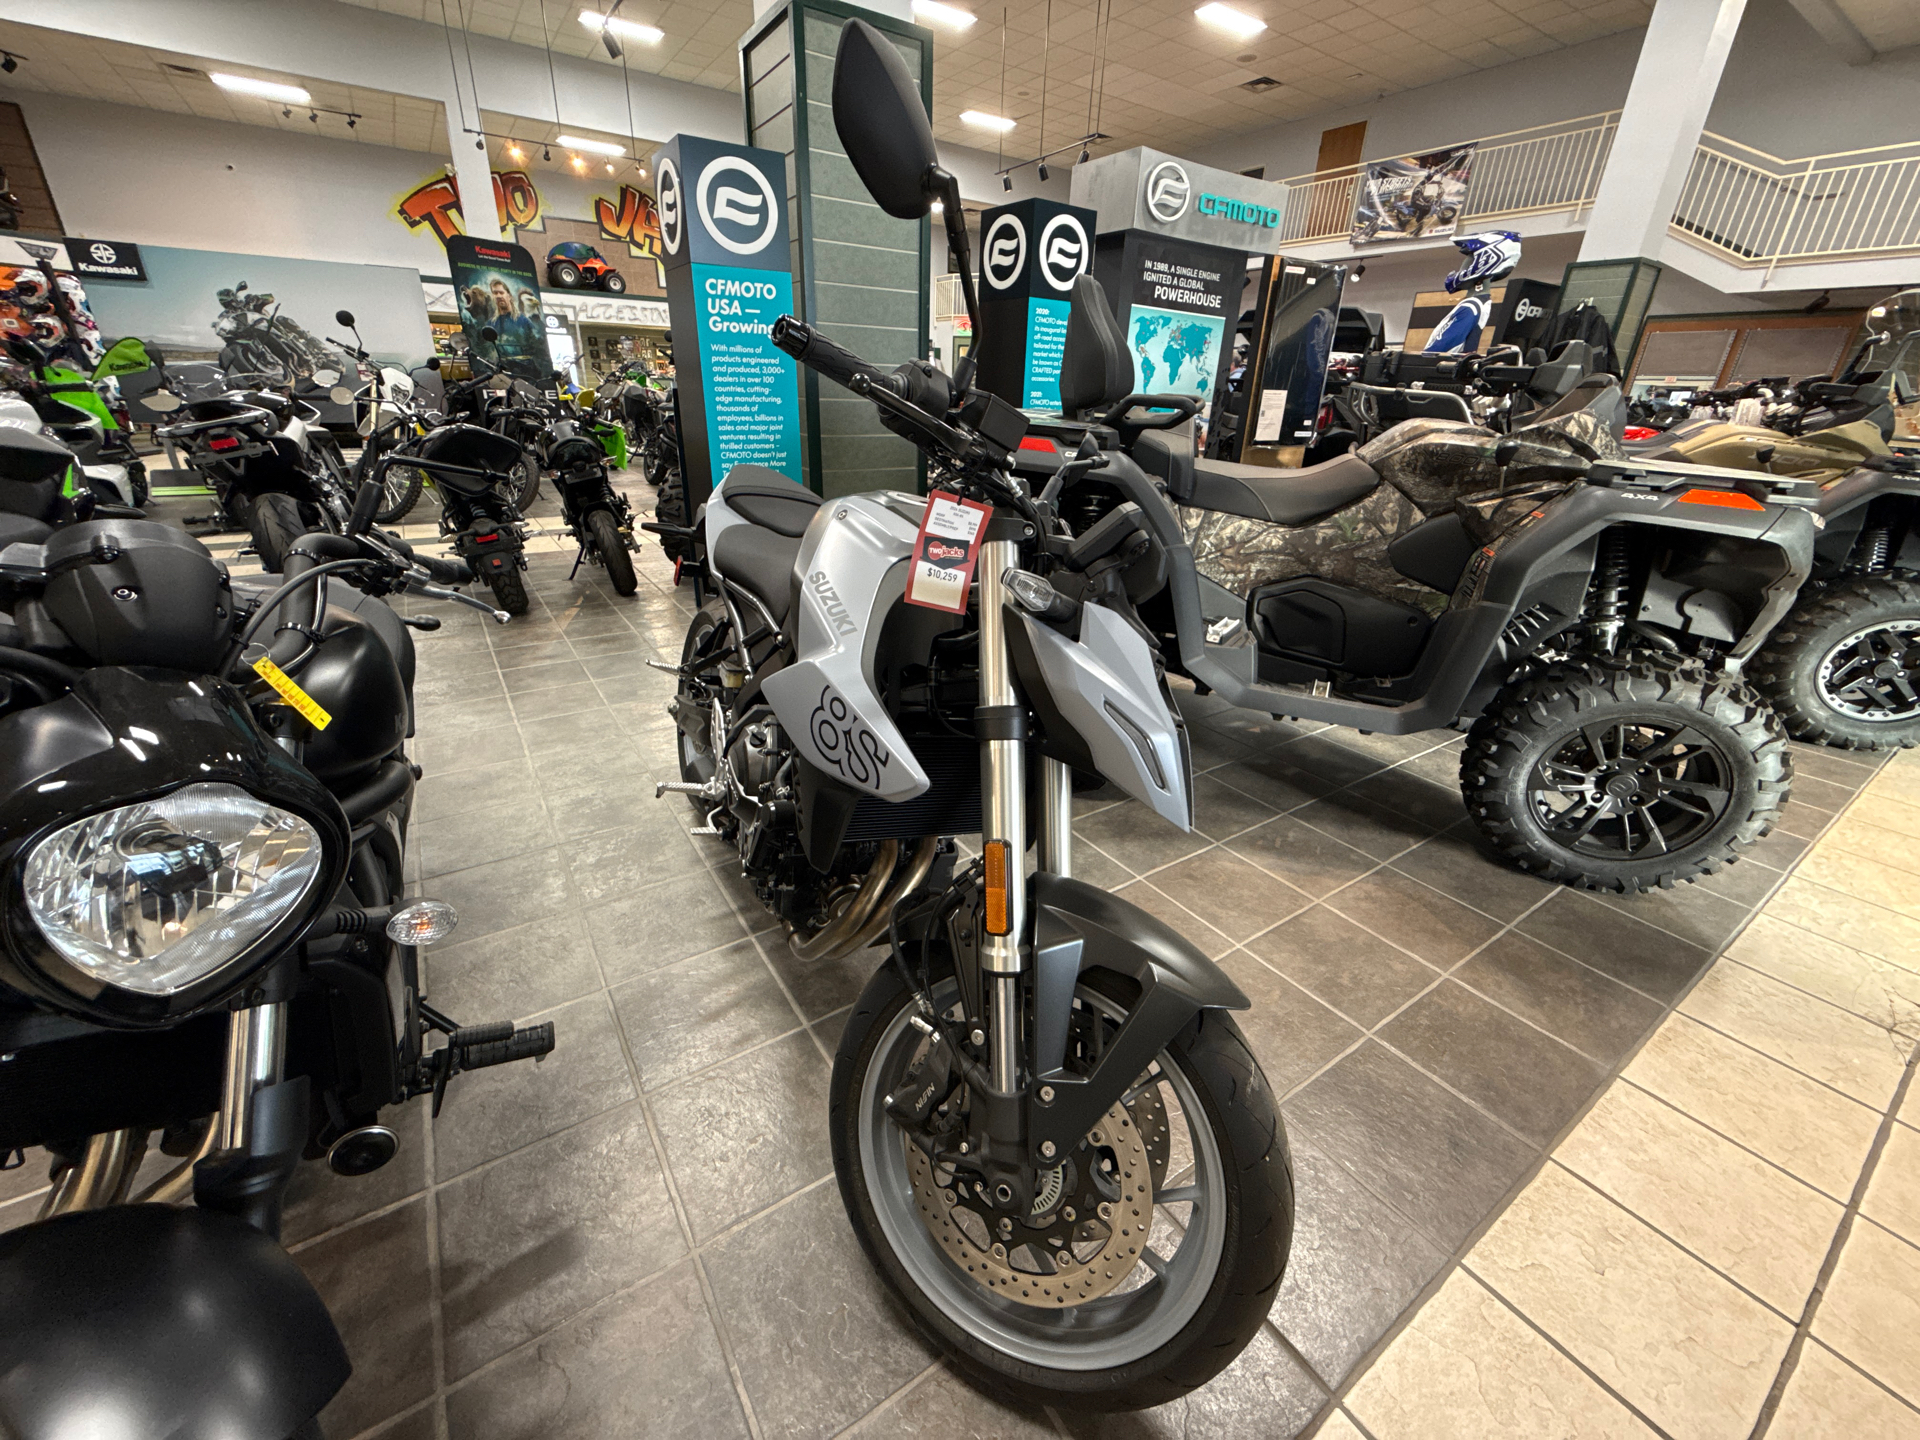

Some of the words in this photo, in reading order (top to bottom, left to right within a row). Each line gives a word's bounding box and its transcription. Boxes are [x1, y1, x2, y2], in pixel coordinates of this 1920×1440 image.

[1199, 193, 1281, 228] CFMOTO
[475, 245, 511, 258] Kawasaki
[78, 262, 138, 276] Kawasaki
[1145, 260, 1153, 269] IN
[1153, 262, 1170, 274] 1989,
[1170, 265, 1176, 273] A
[1176, 266, 1198, 278] SINGLE
[1198, 270, 1220, 282] ENGINE
[1144, 271, 1172, 284] IGNITED
[1172, 276, 1178, 286] A
[1179, 278, 1204, 290] GLOBAL
[705, 278, 777, 300] CFMOTO
[1154, 286, 1222, 308] POWERHOUSE
[707, 298, 742, 316] USA
[1034, 316, 1056, 324] CFMOTO
[711, 344, 728, 352] With
[729, 344, 754, 354] millions
[755, 346, 762, 354] of
[712, 354, 741, 364] products
[742, 357, 780, 366] engineered
[712, 364, 726, 372] and
[728, 365, 760, 374] produced,
[762, 366, 786, 374] 3,000+
[714, 374, 738, 382] dealers
[763, 376, 775, 384] 100
[714, 385, 746, 394] countries,
[715, 394, 732, 404] edge
[734, 395, 782, 404] manufacturing,
[716, 404, 750, 412] thousands
[751, 404, 758, 412] of
[717, 414, 754, 423] employees,
[754, 414, 776, 422] billions
[750, 424, 768, 432] major
[769, 424, 784, 432] joint
[748, 432, 774, 442] resulting
[720, 442, 742, 450] thrilled
[775, 452, 786, 460] just
[927, 568, 958, 583] $10,259
[809, 570, 858, 638] SUZUKI
